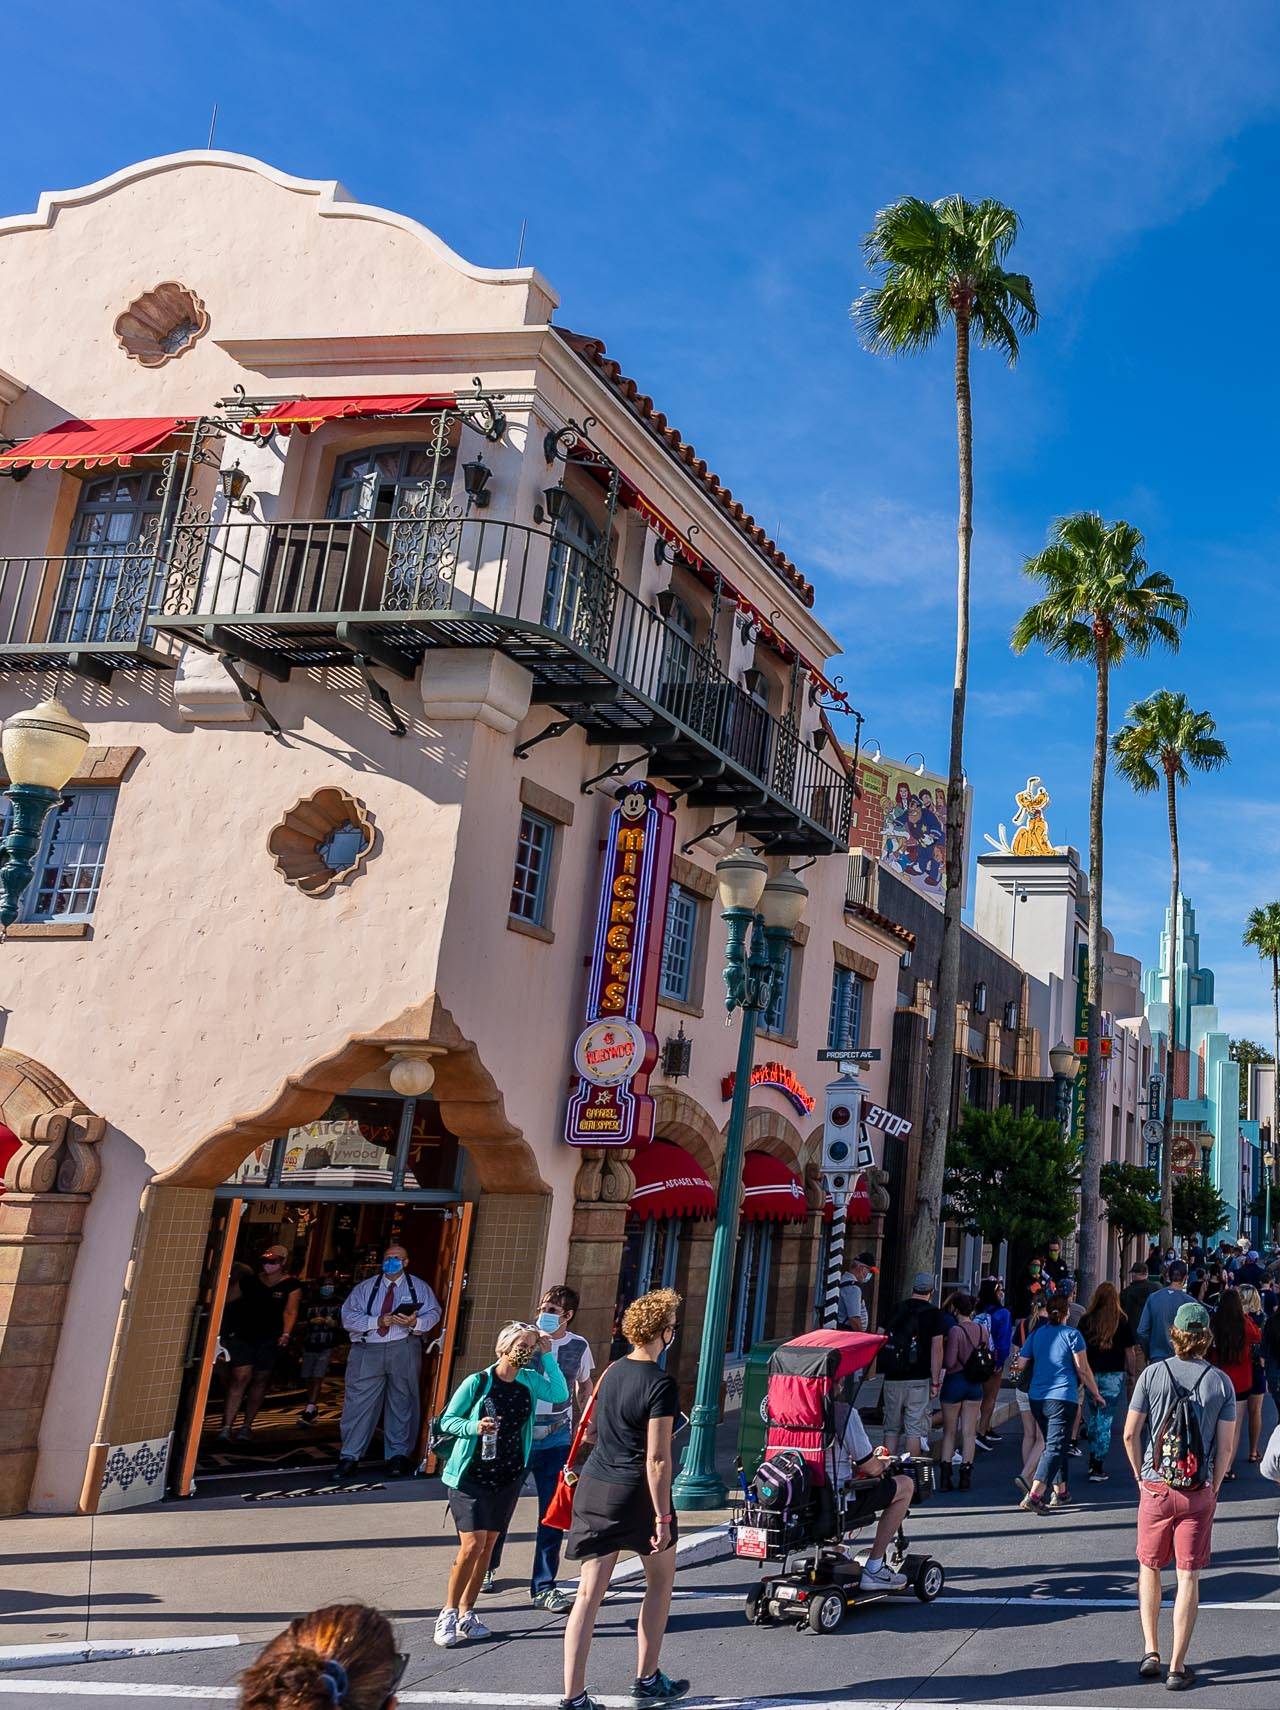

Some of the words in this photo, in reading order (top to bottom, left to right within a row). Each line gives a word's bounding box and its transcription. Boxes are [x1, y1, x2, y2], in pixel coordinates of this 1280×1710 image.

[601, 828, 645, 1010] MICKEY'S
[826, 1051, 859, 1059] PROSPECT
[865, 1105, 913, 1138] STOP
